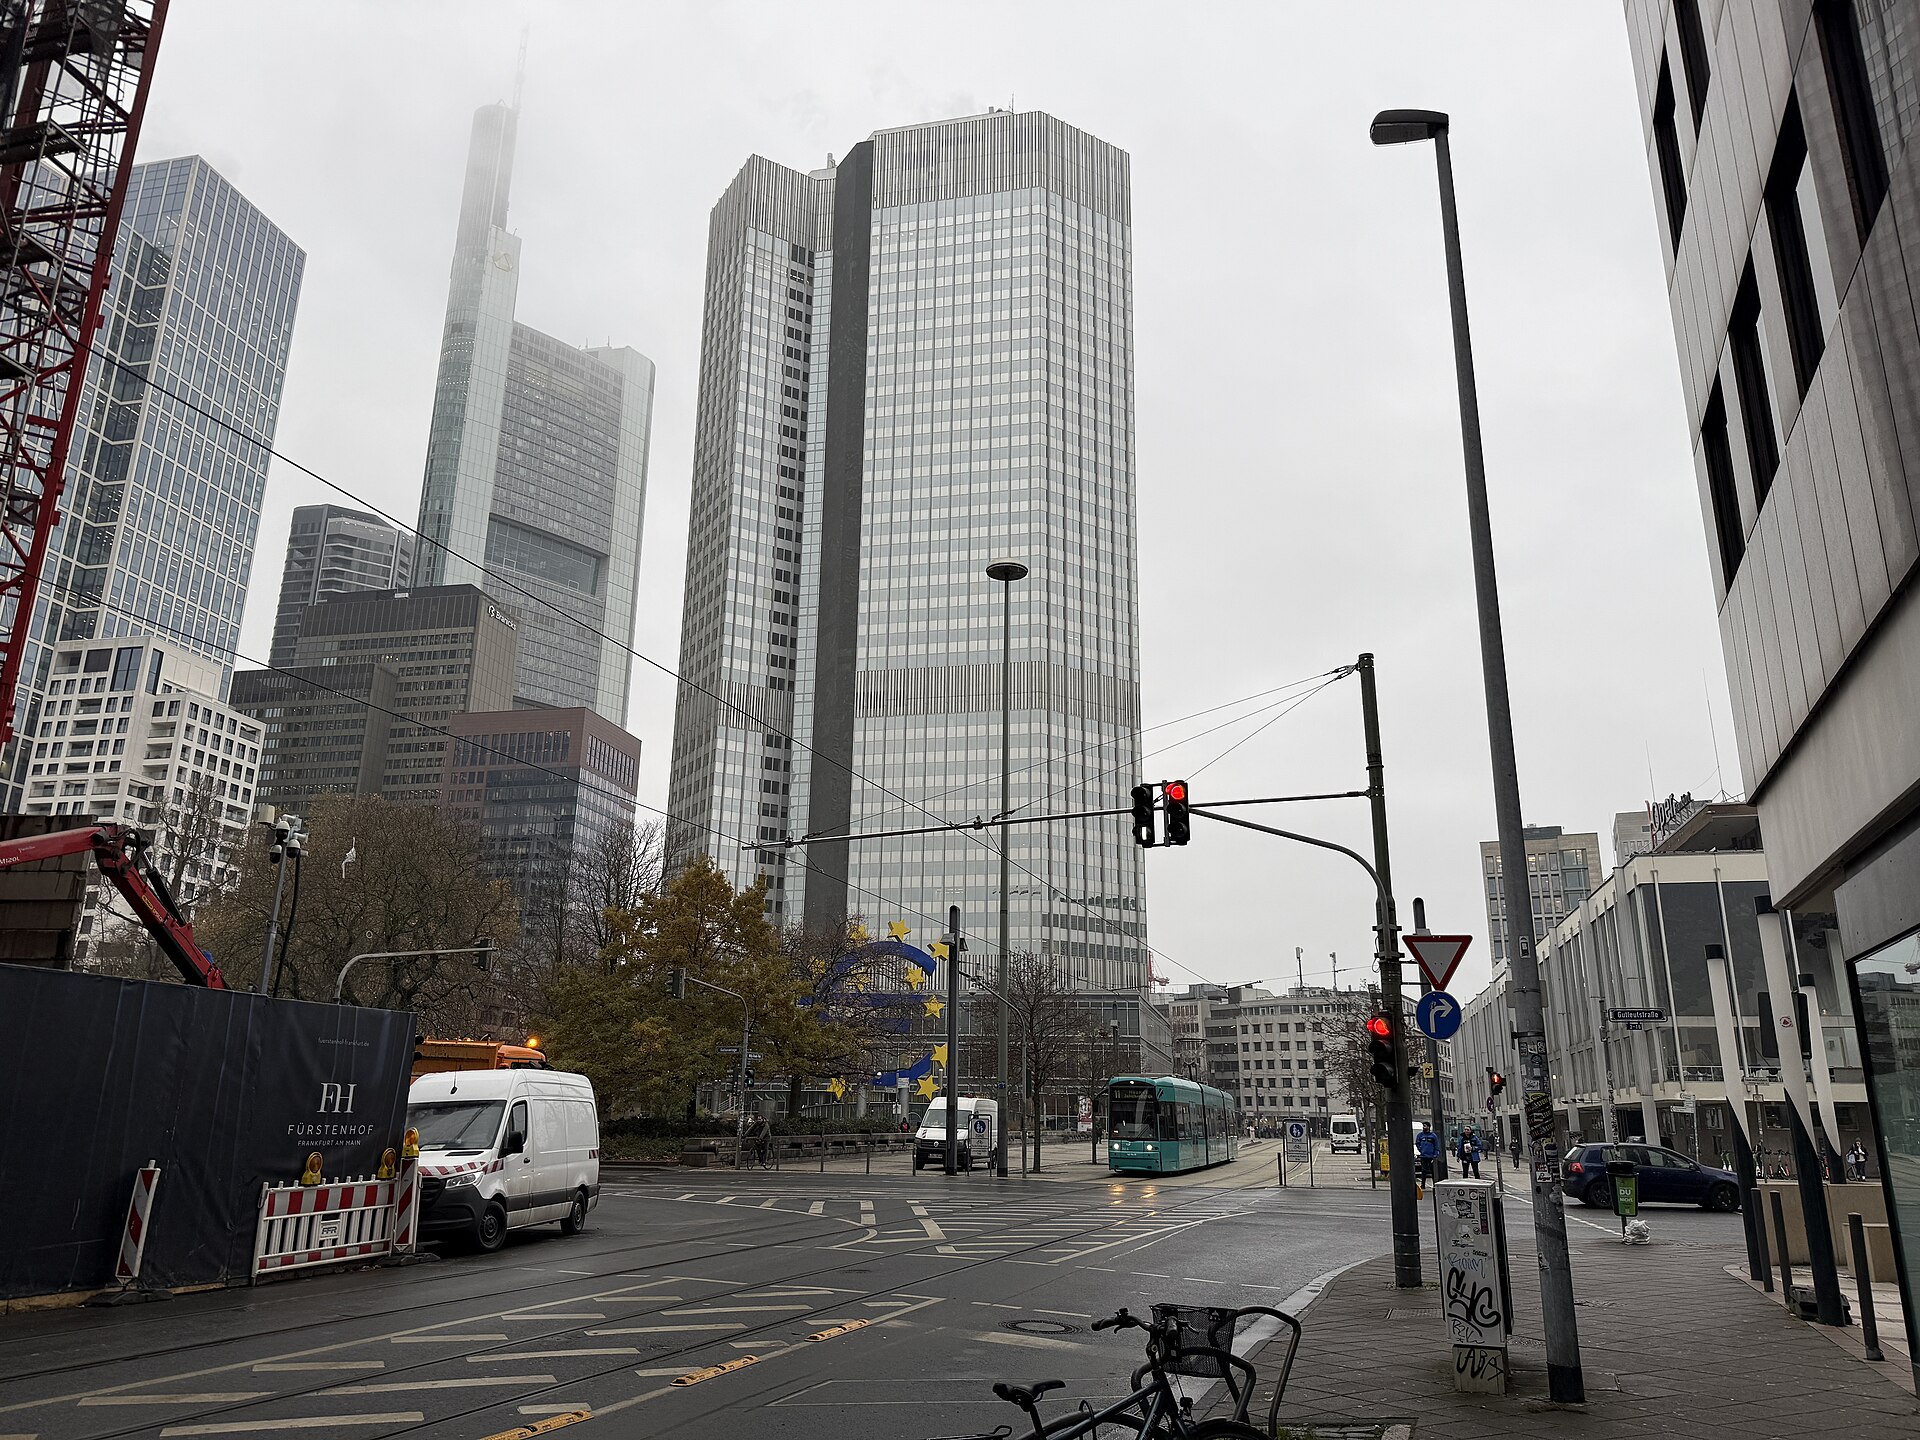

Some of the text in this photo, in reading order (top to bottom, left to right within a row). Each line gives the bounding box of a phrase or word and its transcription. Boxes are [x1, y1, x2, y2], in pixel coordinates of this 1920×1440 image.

[1652, 793, 1675, 838] Oper
[1617, 1011, 1659, 1019] Gutleutstraße
[287, 1122, 374, 1136] FÜRSTENHOF
[297, 1139, 361, 1147] FRANKFURT AM MAIN
